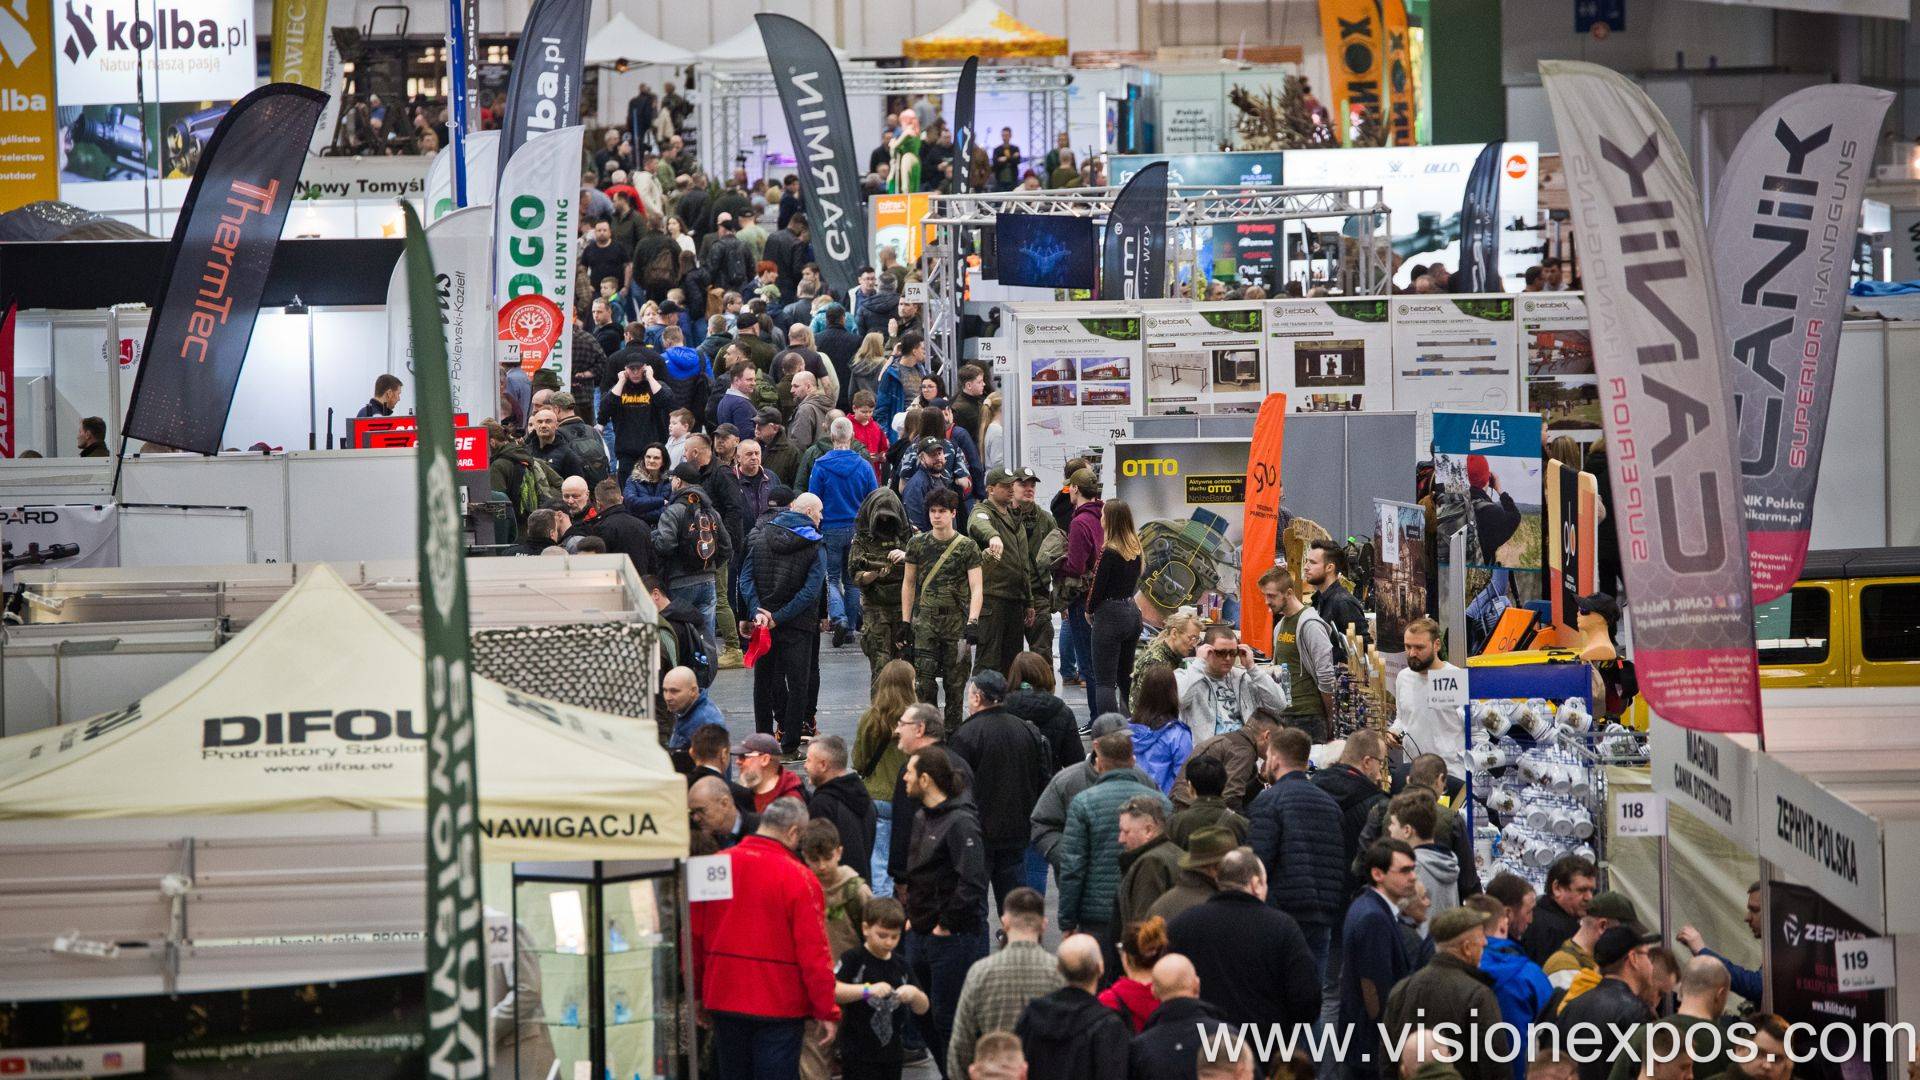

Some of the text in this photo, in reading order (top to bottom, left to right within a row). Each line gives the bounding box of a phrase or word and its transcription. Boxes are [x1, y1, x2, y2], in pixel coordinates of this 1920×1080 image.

[106, 8, 248, 55] kolba.pl
[100, 58, 142, 73] Natur
[297, 178, 425, 197] Nowy Tomyśl
[555, 198, 569, 279] HUNTING
[181, 178, 281, 363] ThermTec
[1789, 138, 1858, 468] SUPERIOR HANDGUNS
[508, 345, 519, 354] 77
[981, 342, 992, 351] 78
[995, 355, 1007, 365] 79
[1109, 430, 1126, 440] 79A
[1471, 419, 1500, 440] 446
[1122, 458, 1179, 477] OTTO
[1207, 485, 1232, 493] OTTO
[1765, 496, 1805, 510] Polska
[1432, 678, 1458, 691] 117A
[201, 746, 337, 760] Protraktory
[264, 762, 393, 773] www.difou.eu
[1621, 802, 1644, 819] 118
[1777, 794, 1858, 886] ZEPHYR POLSKA
[706, 866, 727, 882] 89
[1841, 950, 1869, 971] 119
[29, 1057, 84, 1073] YouTube
